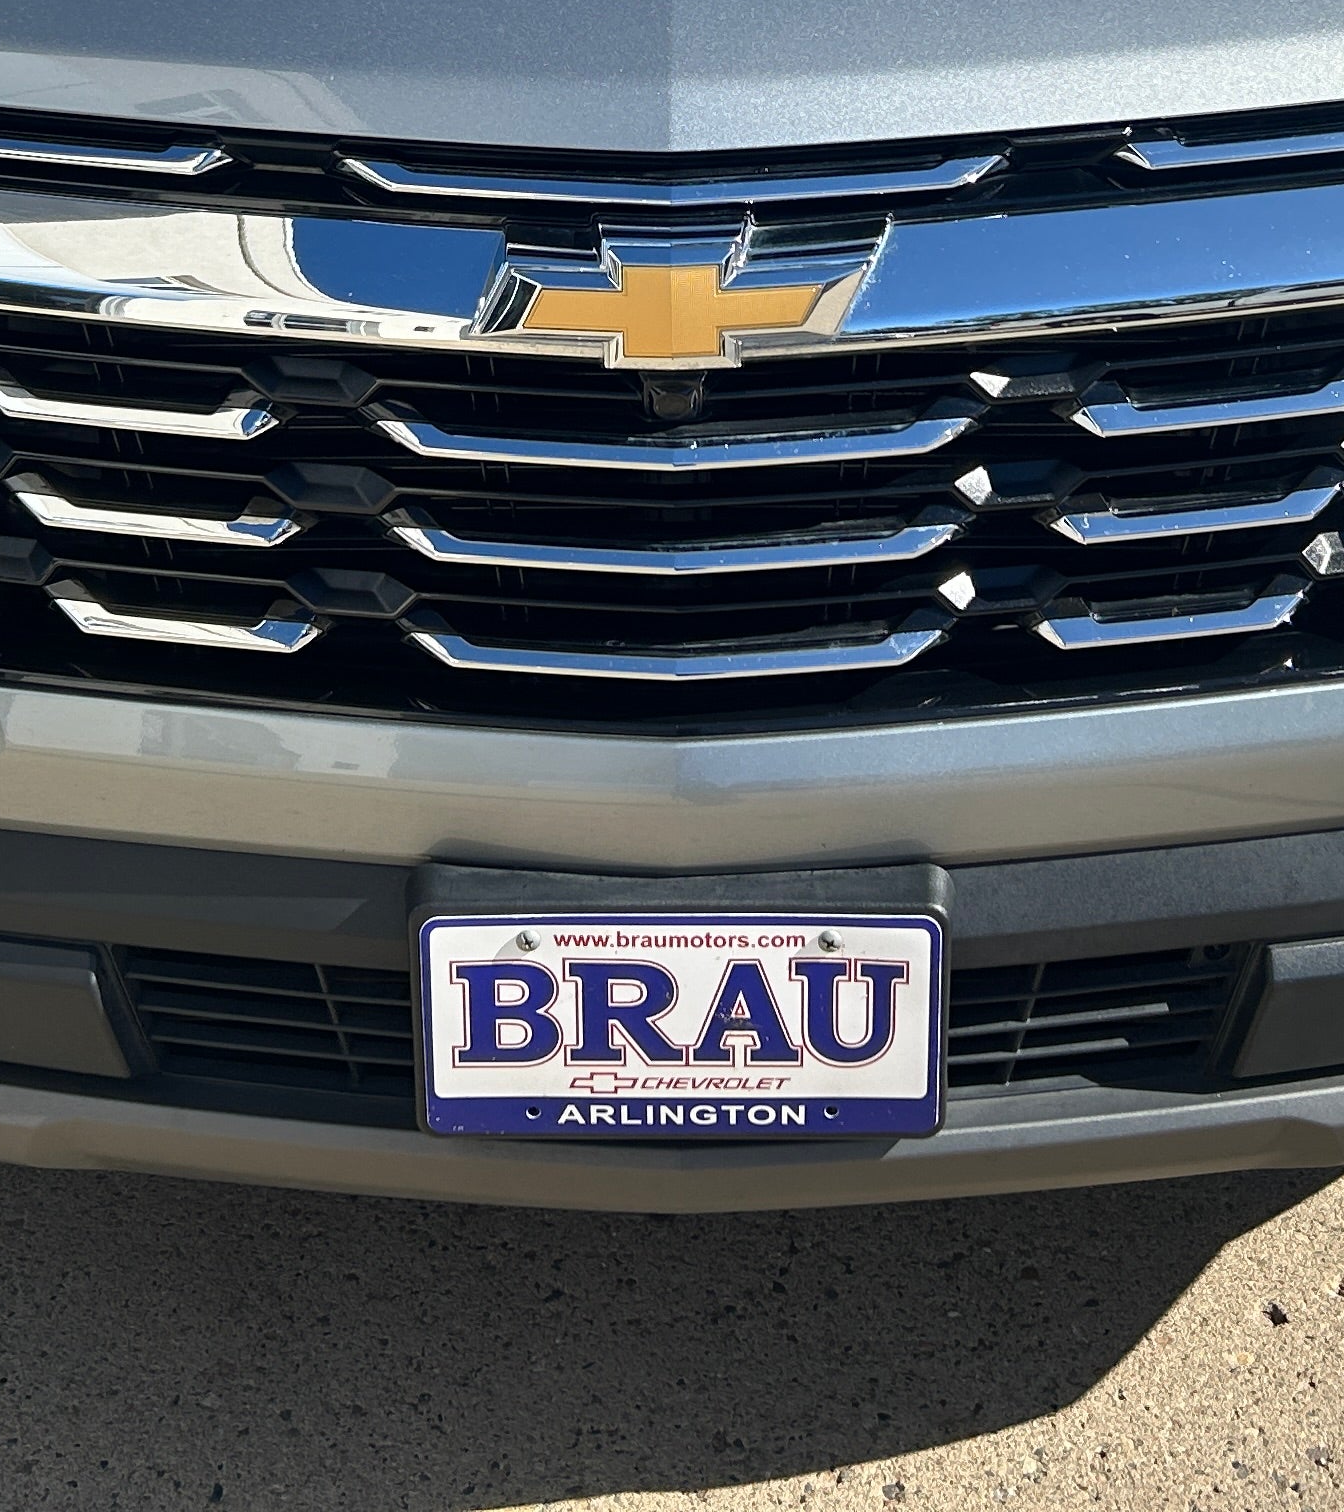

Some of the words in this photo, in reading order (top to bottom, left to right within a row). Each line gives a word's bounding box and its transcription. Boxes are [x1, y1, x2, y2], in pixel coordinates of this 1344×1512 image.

[553, 930, 806, 949] www.braumotors.com
[448, 957, 910, 1069] BRAU
[640, 1076, 791, 1091] CHEVROLET
[557, 1103, 807, 1127] ARLINGTON
